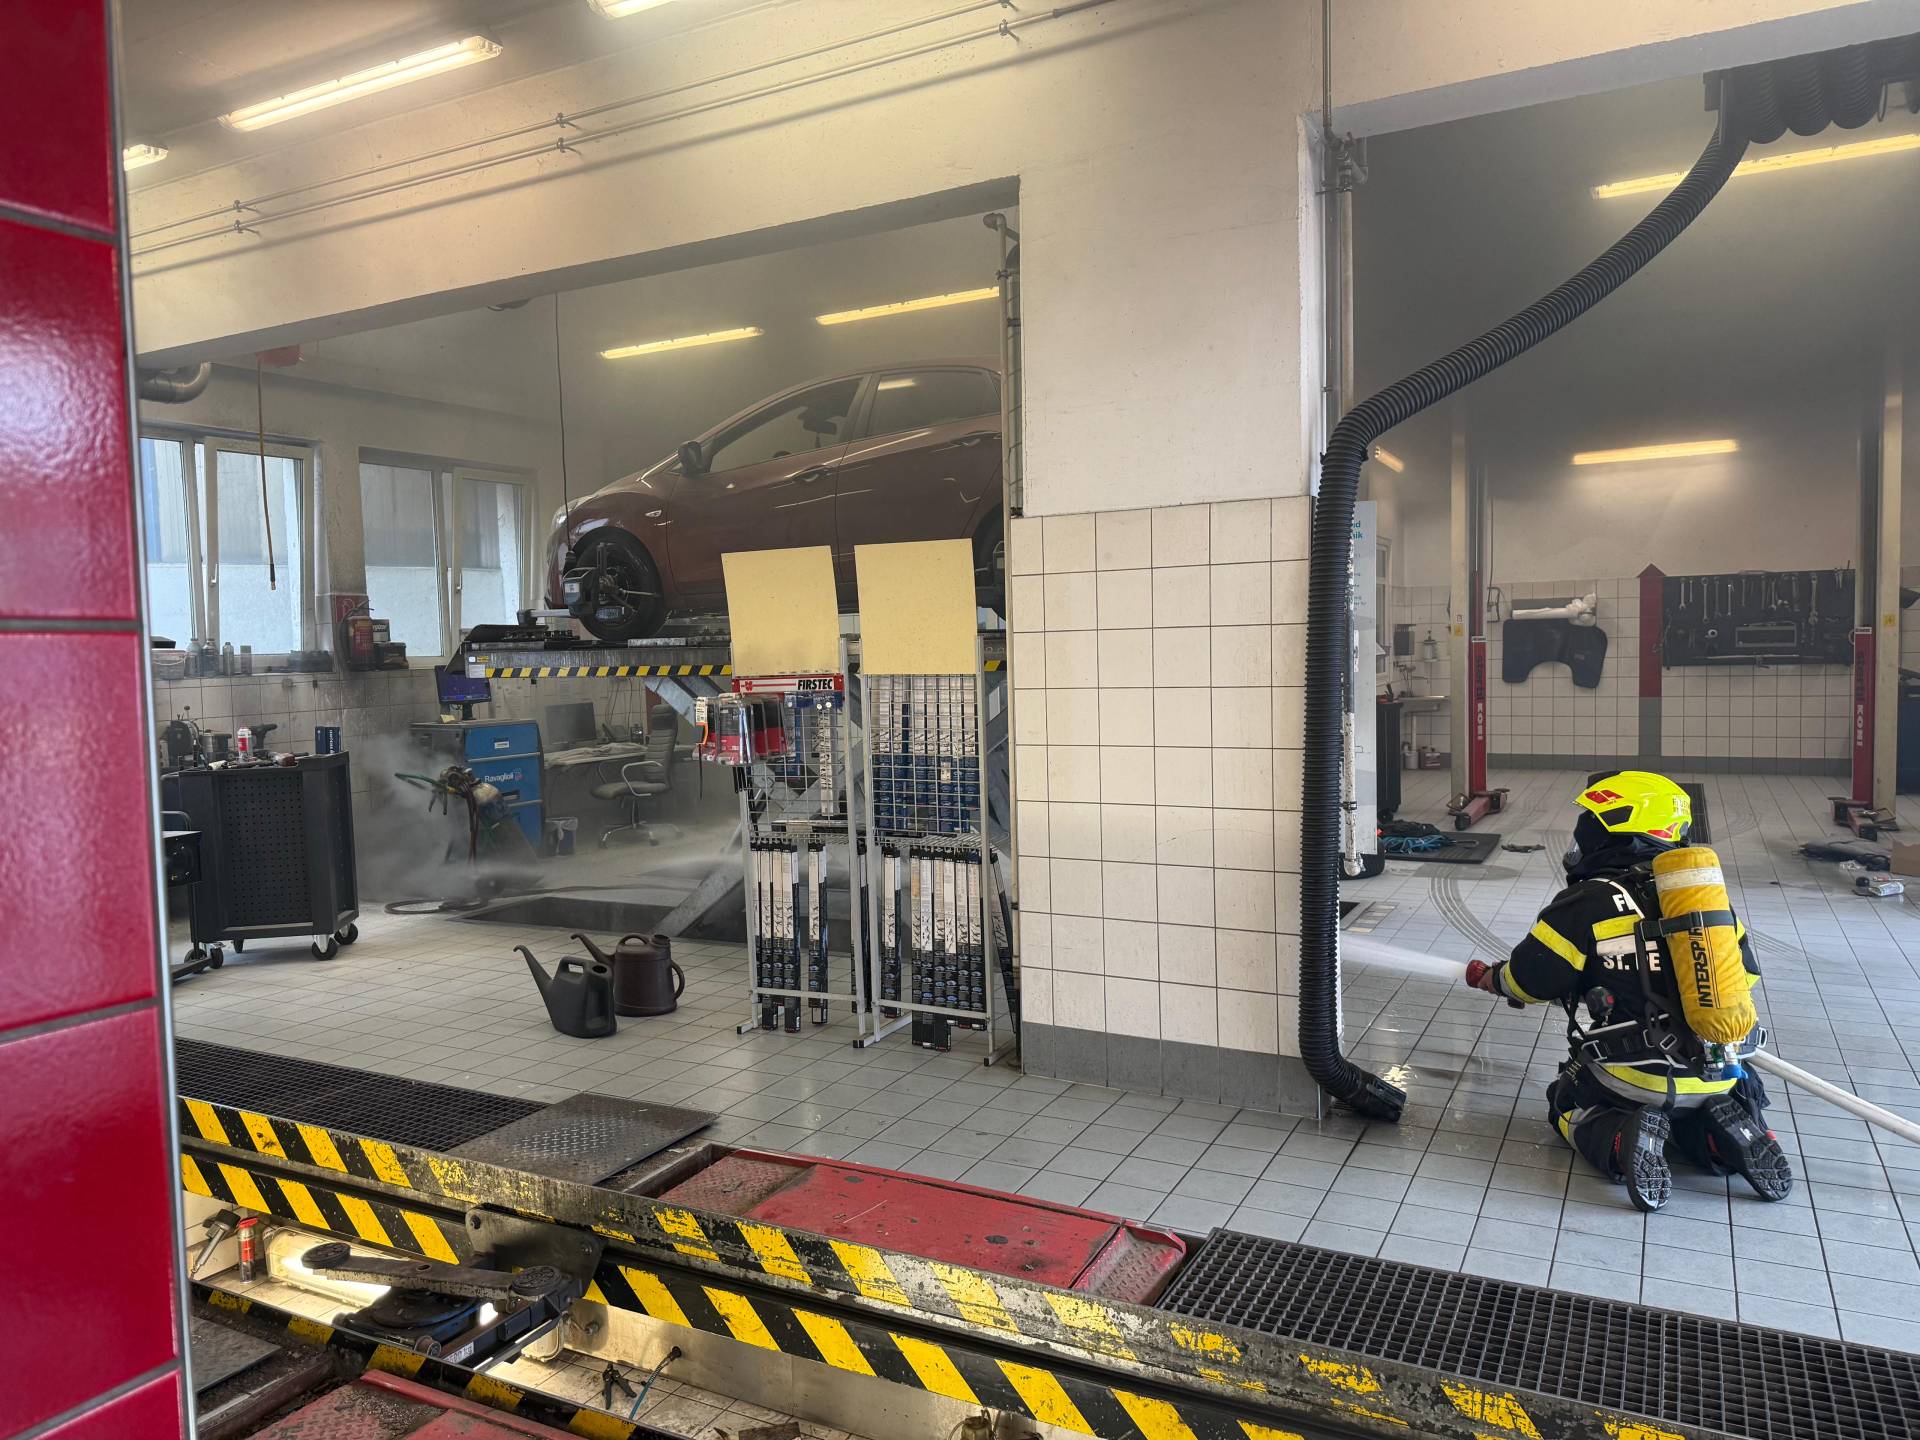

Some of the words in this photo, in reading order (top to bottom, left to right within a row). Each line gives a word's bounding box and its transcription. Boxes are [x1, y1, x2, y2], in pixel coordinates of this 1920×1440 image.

[797, 679, 833, 690] FIRSTEC
[1856, 704, 1864, 746] KONI
[1688, 926, 1714, 1008] INTERSPIR
